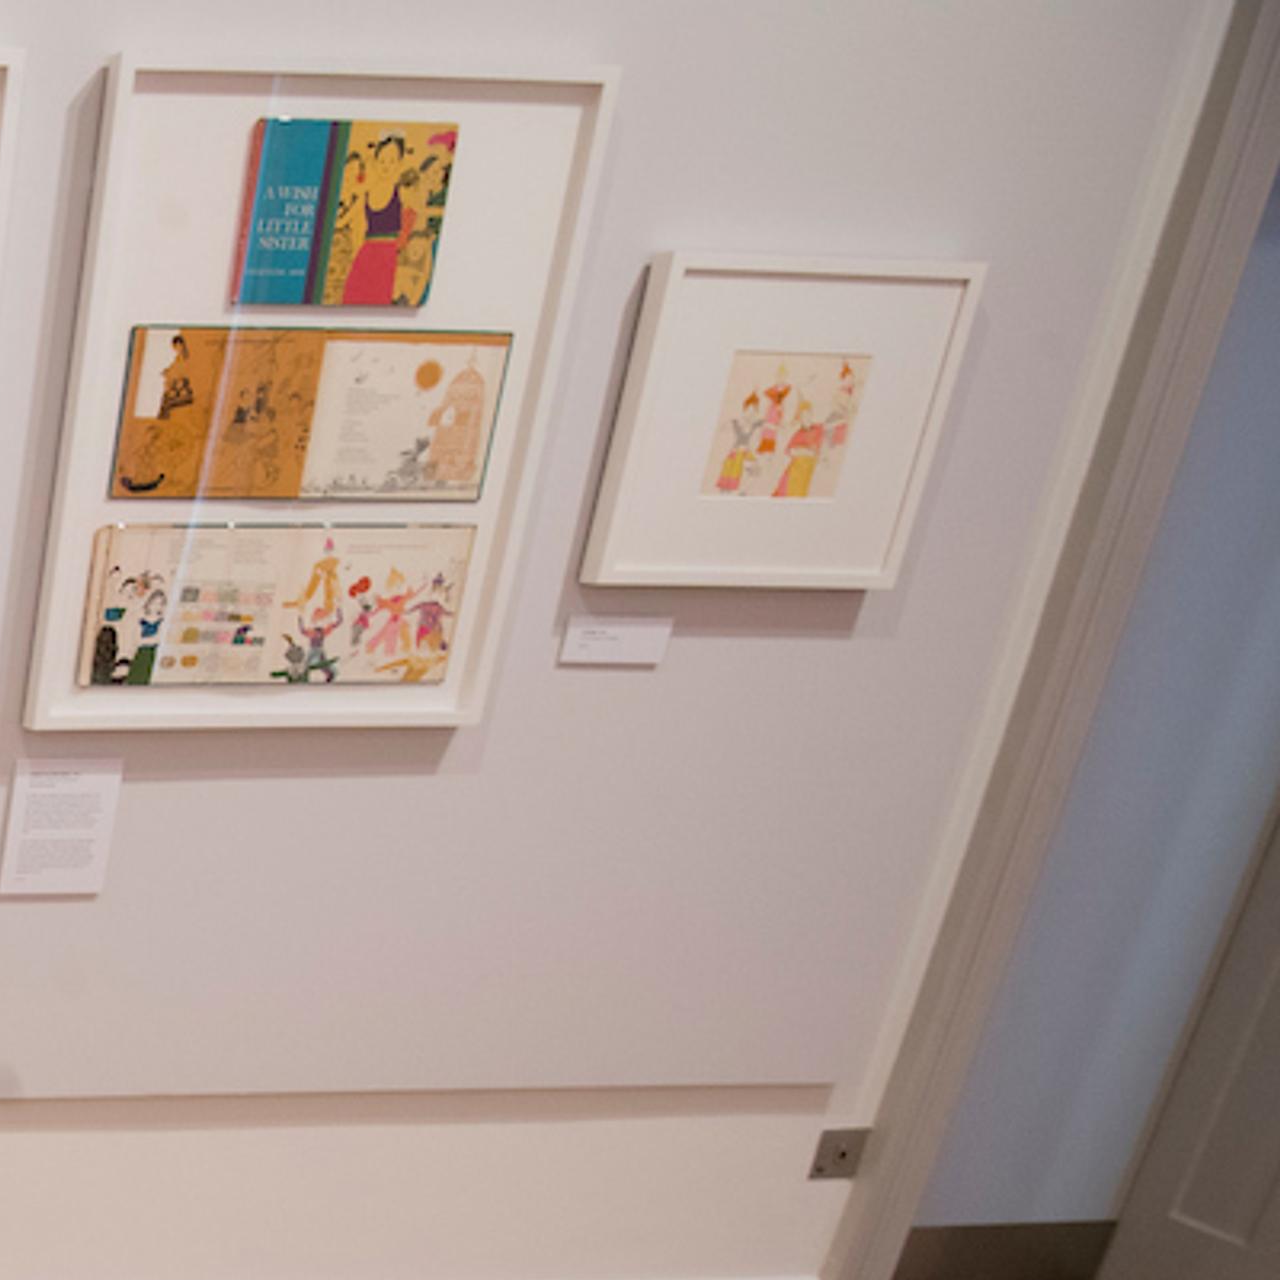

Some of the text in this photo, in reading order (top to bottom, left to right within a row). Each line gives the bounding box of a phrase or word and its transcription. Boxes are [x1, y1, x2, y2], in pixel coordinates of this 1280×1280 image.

[284, 203, 315, 217] FOR
[255, 218, 313, 234] LITTLE
[257, 236, 311, 251] SISTER
